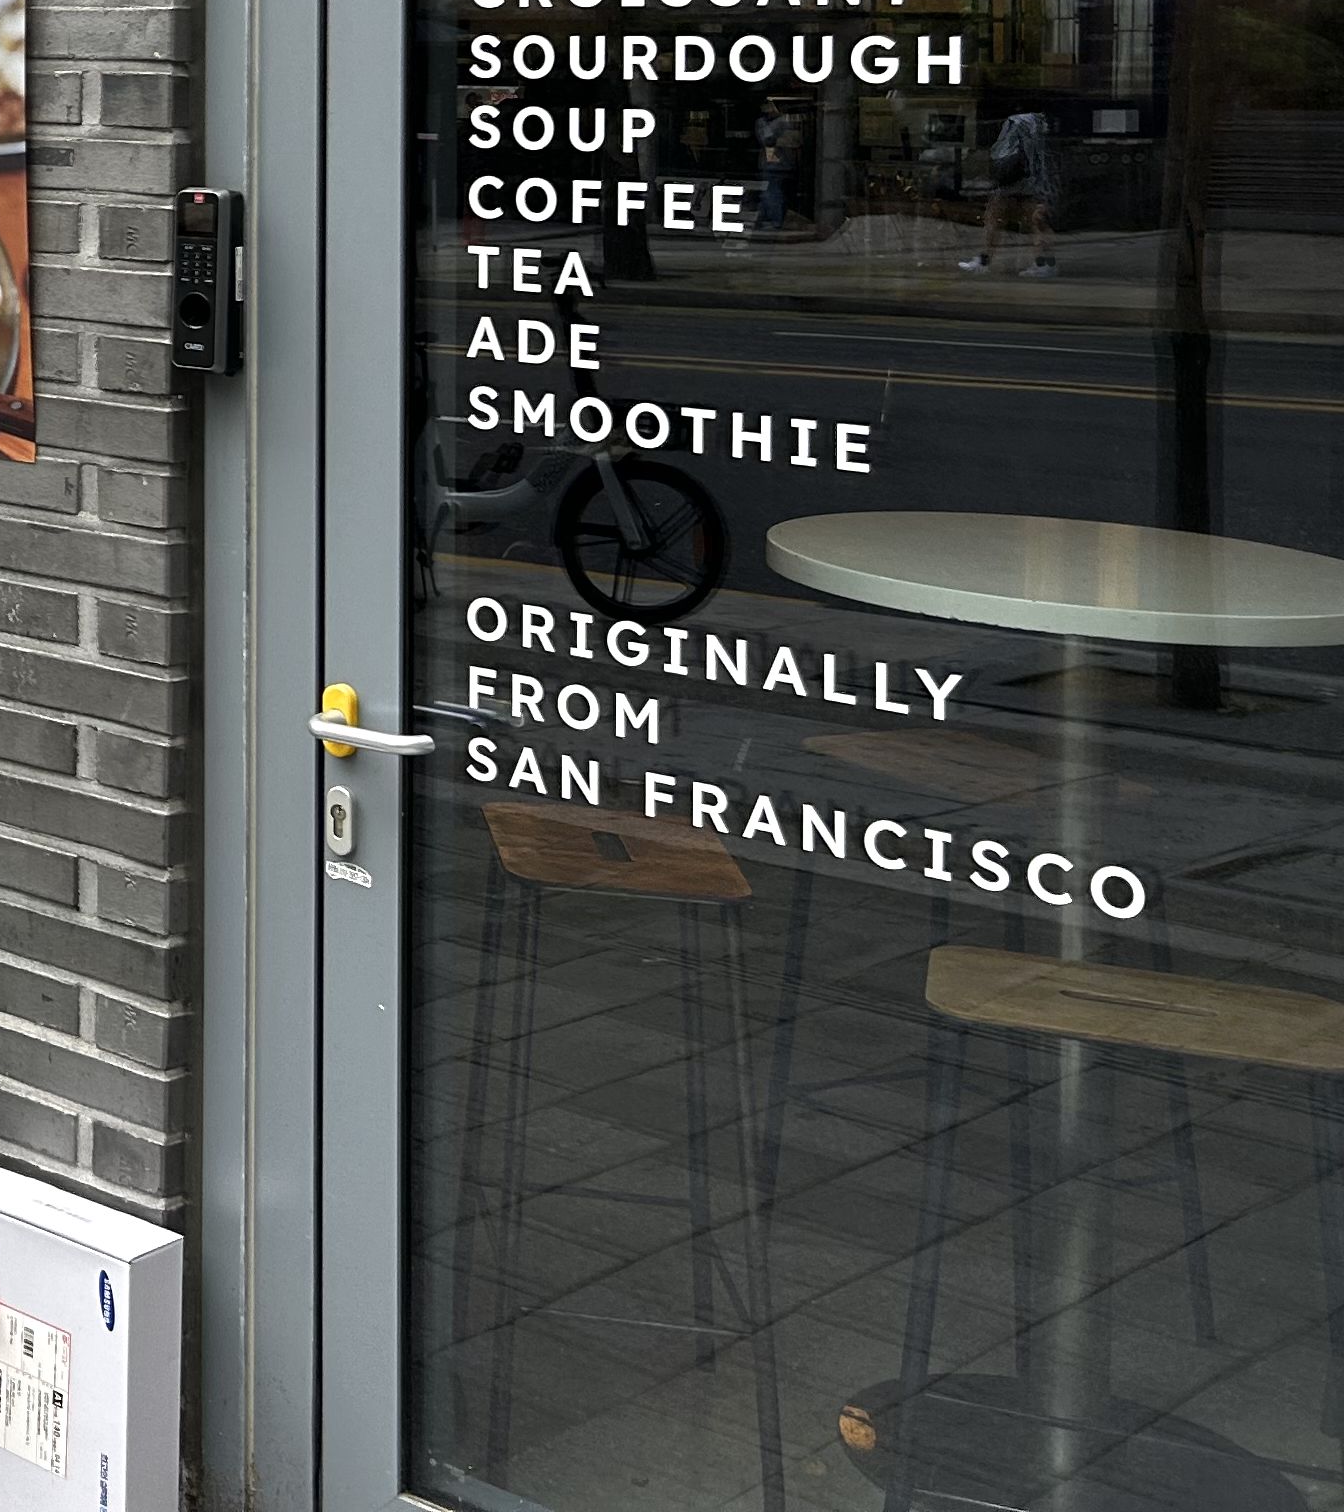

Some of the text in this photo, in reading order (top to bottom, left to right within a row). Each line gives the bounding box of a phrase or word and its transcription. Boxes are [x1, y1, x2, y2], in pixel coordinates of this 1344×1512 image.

[469, 34, 963, 85] SOURDOUGH
[468, 104, 656, 153] SOUP
[468, 175, 744, 233] COFFEE
[467, 245, 594, 297] TEA
[466, 316, 600, 370] ADE
[467, 385, 870, 473] SMOOTHIE
[467, 597, 962, 721] ORIGINALLY
[468, 665, 658, 744] FROM
[466, 737, 1146, 919] SAN FRANCISCO
[52, 1389, 64, 1408] A1
